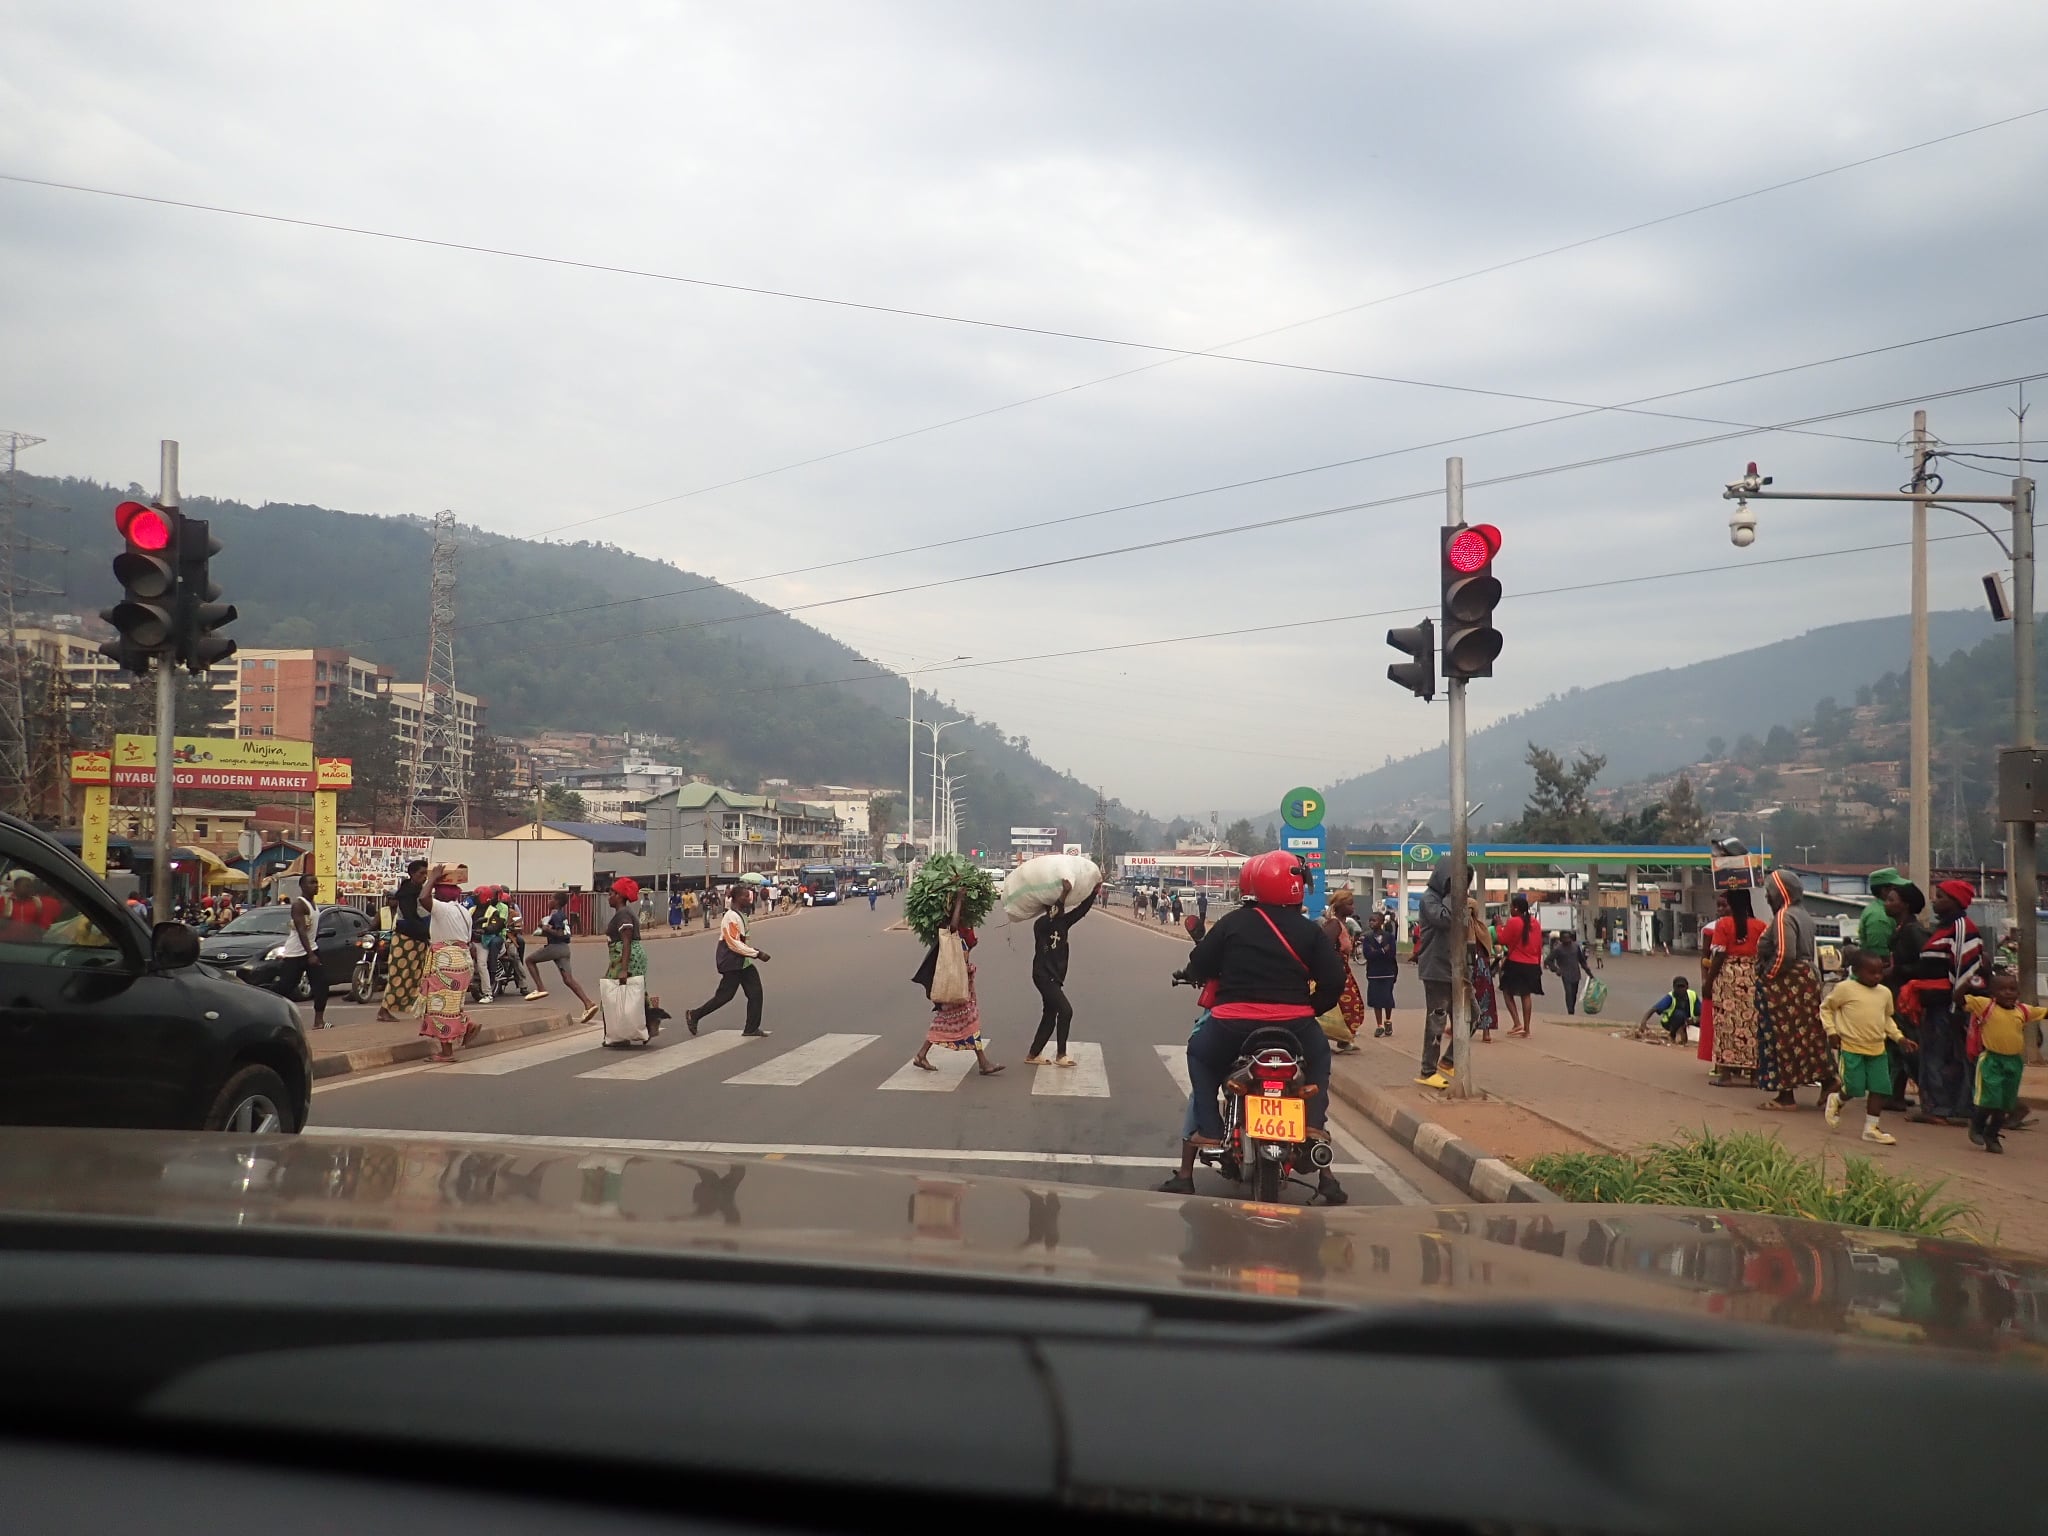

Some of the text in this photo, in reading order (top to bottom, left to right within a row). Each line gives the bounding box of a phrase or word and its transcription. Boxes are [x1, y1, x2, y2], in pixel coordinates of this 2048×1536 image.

[242, 741, 287, 758] Minjira,
[76, 765, 107, 774] MAGGI
[321, 771, 349, 779] MAGGI
[115, 772, 308, 788] NYABUGO MODERN MARKET
[1290, 799, 1317, 819] SP
[340, 835, 431, 850] EJOHEZA MODERN MARKET
[1131, 857, 1157, 865] RUBIS
[1260, 1098, 1283, 1117] RH
